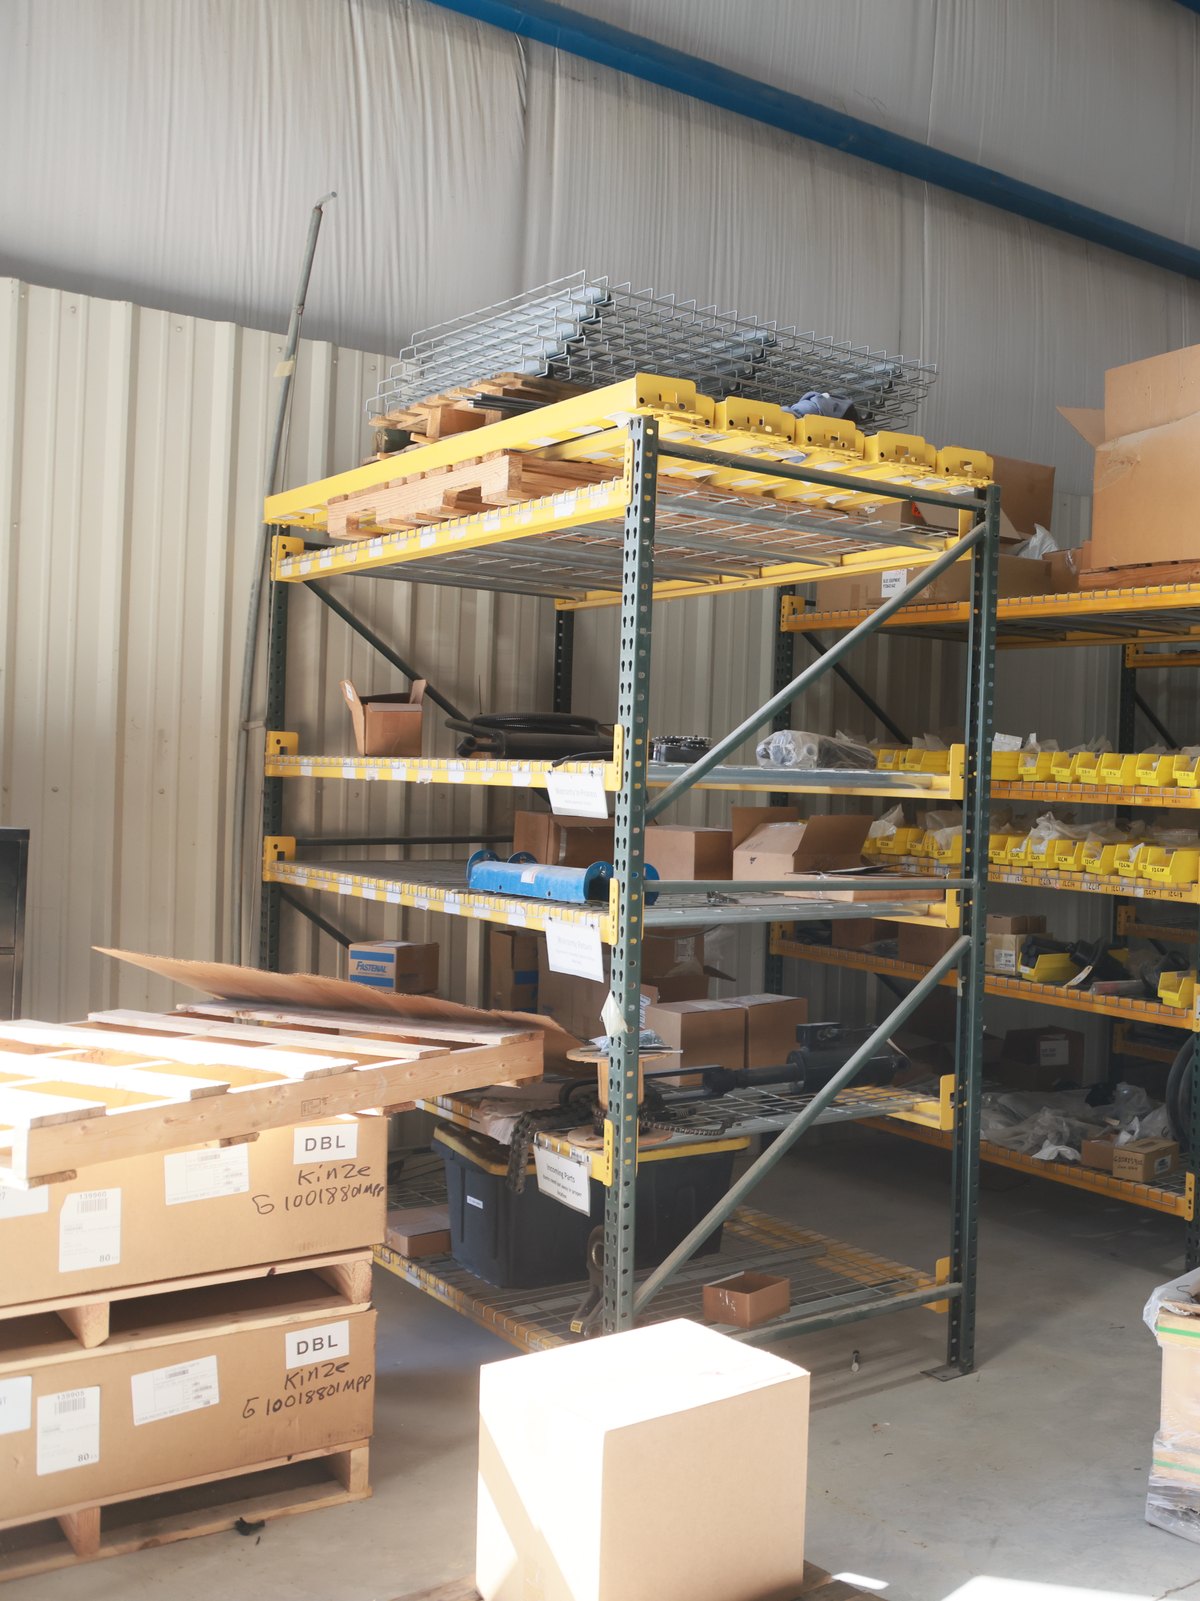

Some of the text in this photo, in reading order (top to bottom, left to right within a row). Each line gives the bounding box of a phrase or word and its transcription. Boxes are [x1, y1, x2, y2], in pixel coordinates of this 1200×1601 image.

[356, 961, 387, 973] FASTENAL
[305, 1135, 346, 1152] DBL
[100, 1254, 111, 1262] 80
[296, 1334, 338, 1356] DBL
[78, 1453, 90, 1462] 80
